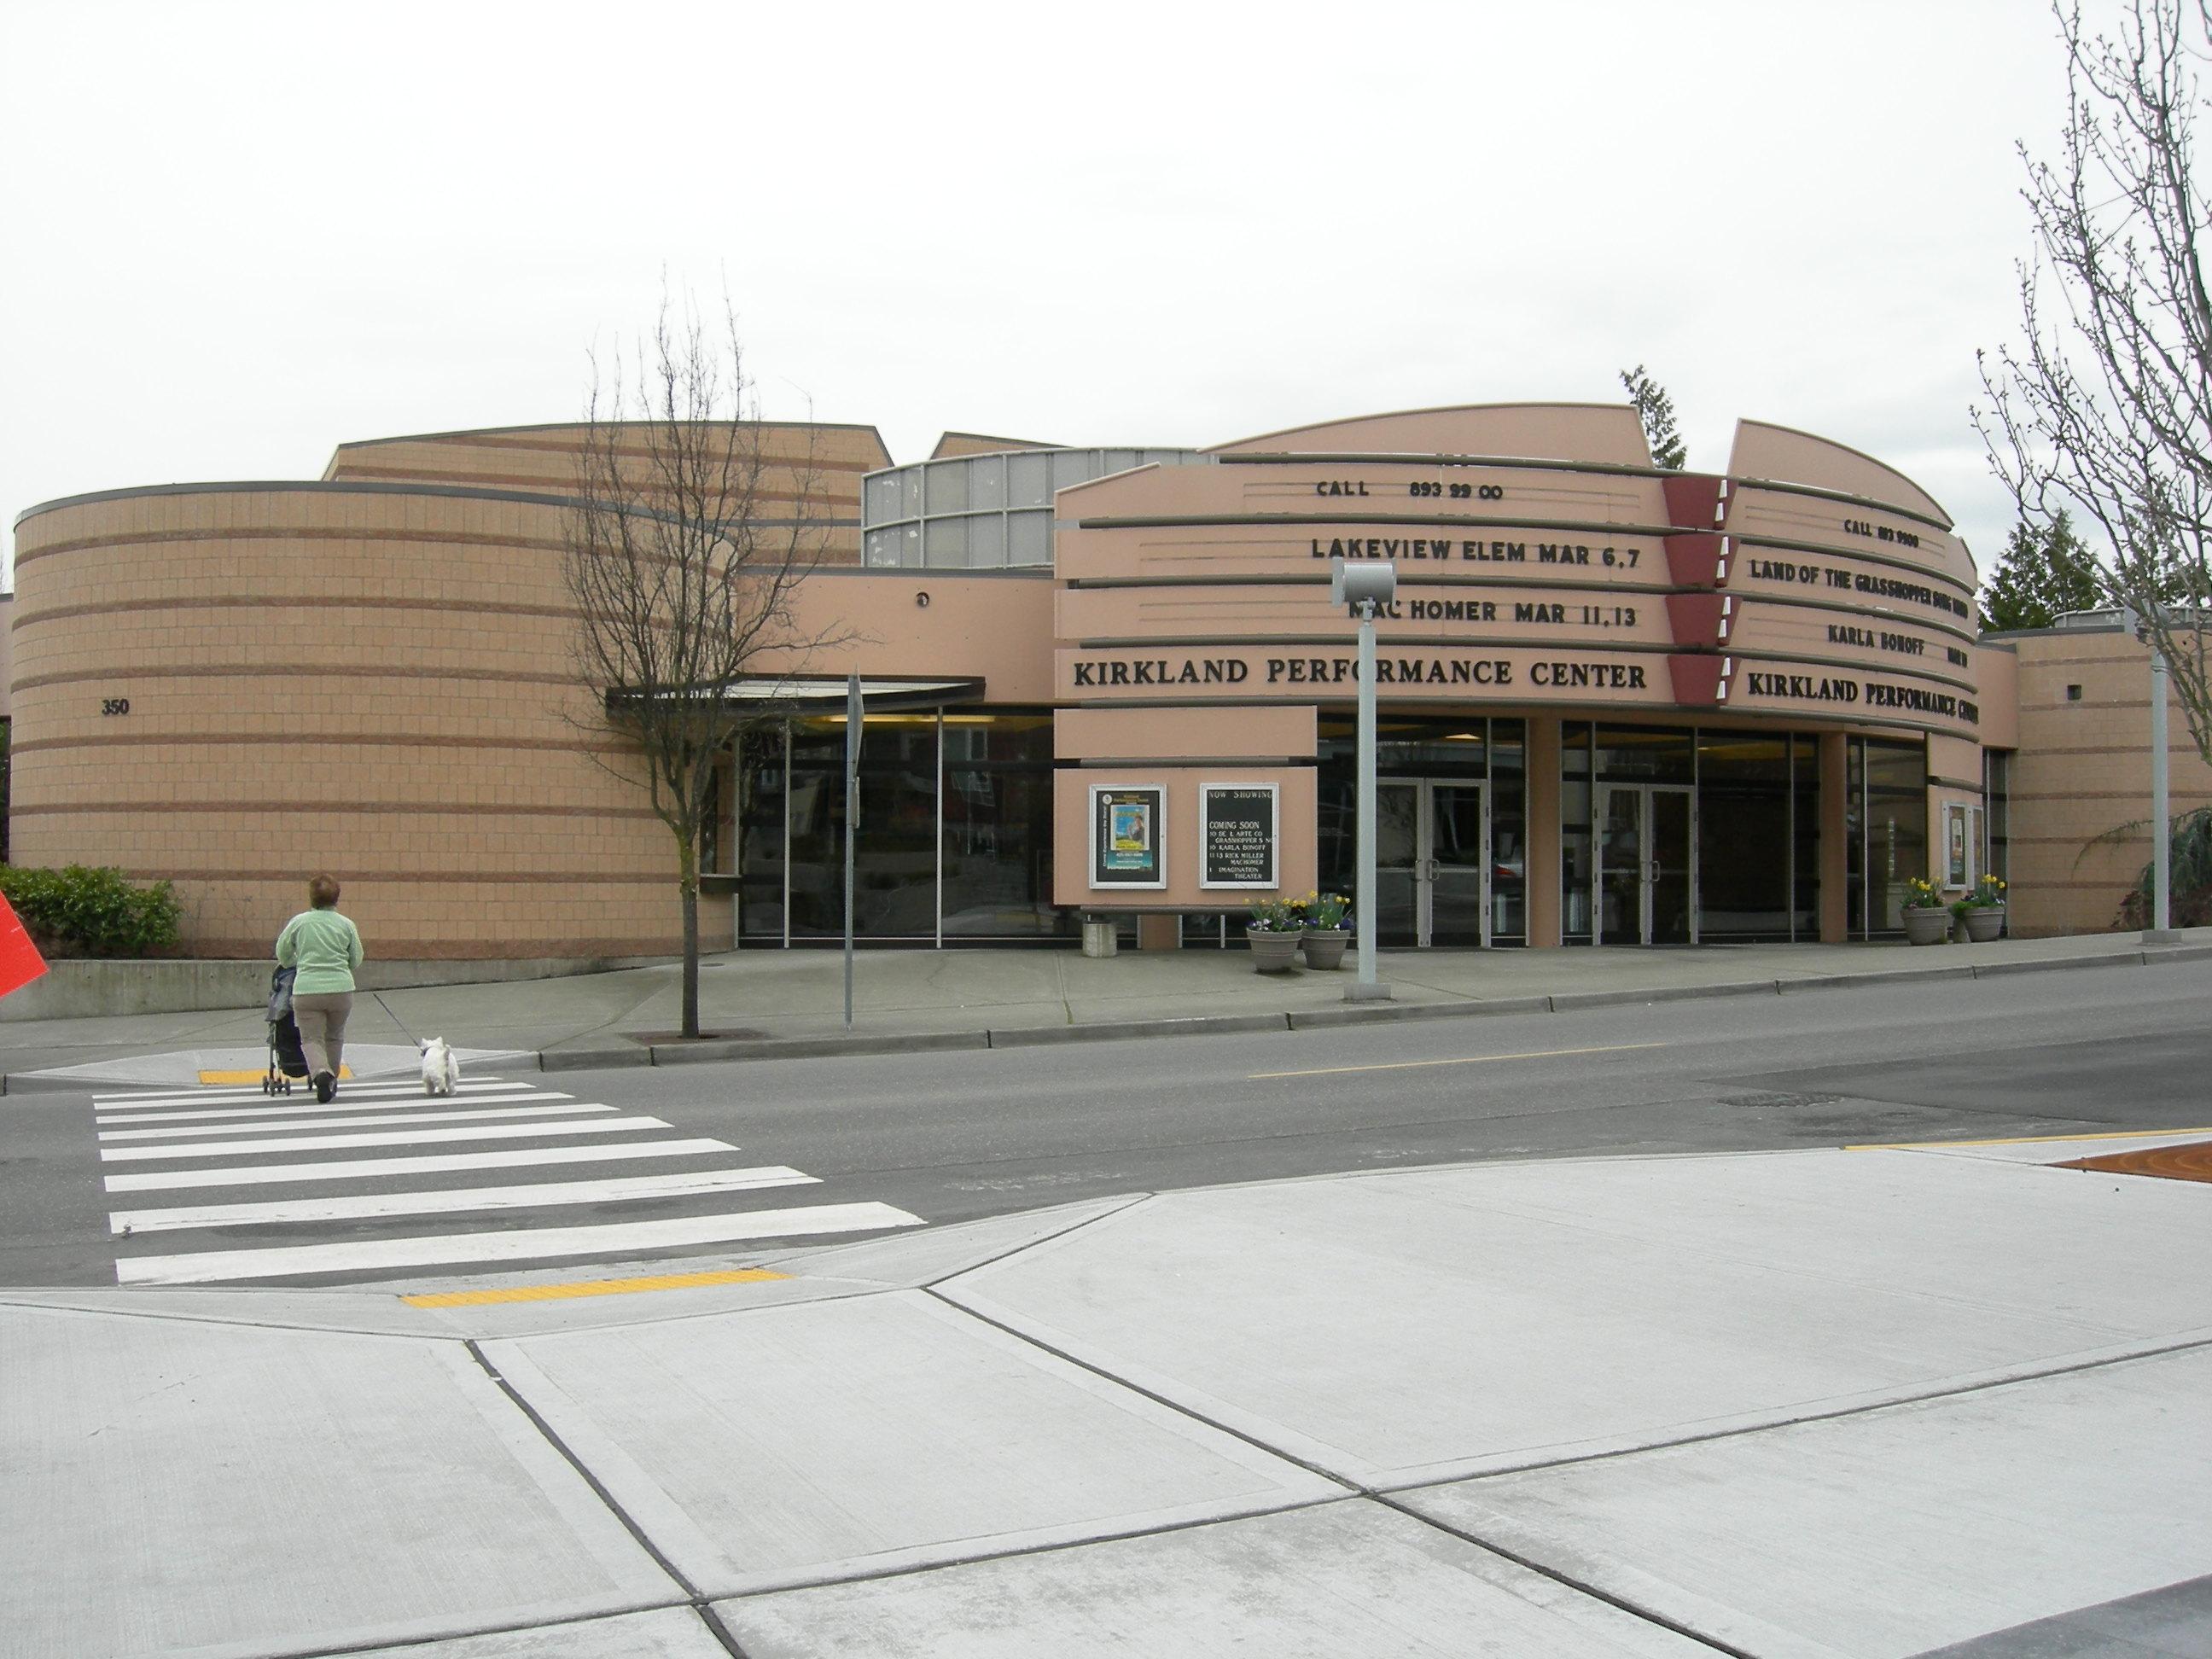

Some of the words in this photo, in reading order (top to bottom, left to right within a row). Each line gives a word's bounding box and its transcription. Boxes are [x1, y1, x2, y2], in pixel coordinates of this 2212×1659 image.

[1316, 480, 1370, 497] CALL
[1410, 481, 1442, 498] 893
[1843, 519, 1873, 537] CALL
[1312, 538, 1452, 560] LAKEVIEW
[1463, 540, 1526, 562] ELEM
[1539, 543, 1590, 565] MAR
[1750, 559, 1796, 582] LAND
[1798, 565, 1820, 584] OF
[1825, 568, 1852, 589] THE
[1410, 599, 1497, 621] HOMER
[1515, 602, 1565, 624] MAR
[1828, 624, 1876, 649] KARLA
[1074, 659, 1249, 685] KIRKLAND
[1529, 661, 1647, 689] CENTER
[102, 698, 130, 715] 350
[1748, 672, 1859, 702] KIRKLAND
[1866, 683, 1957, 717] PERFORMANCE
[1209, 821, 1237, 830] COMING
[1239, 821, 1260, 830] SOON
